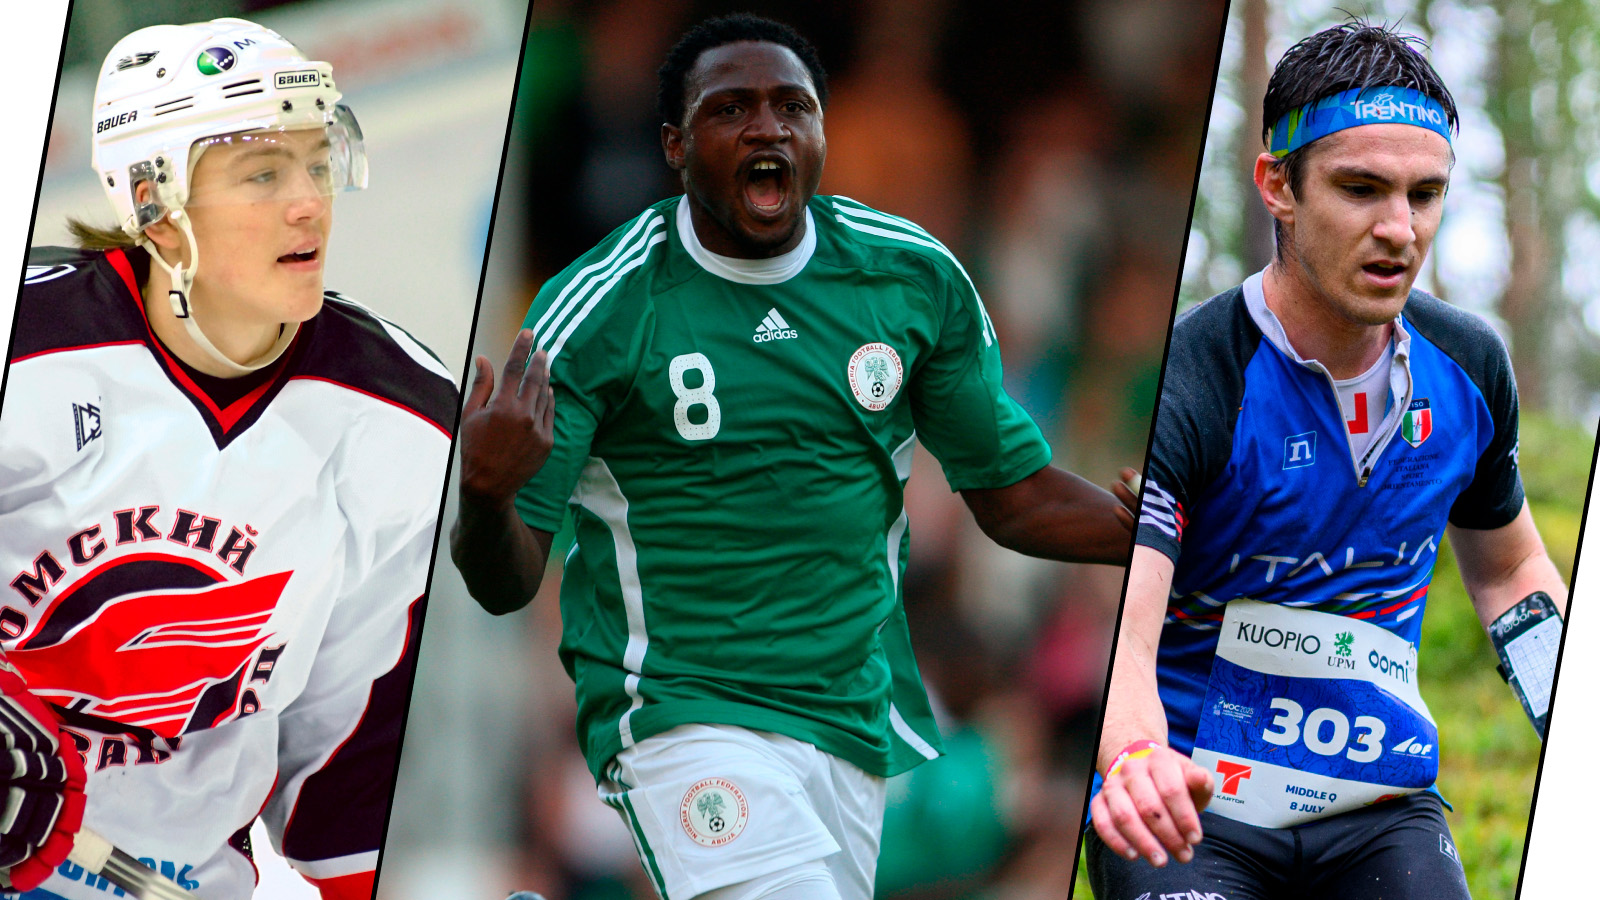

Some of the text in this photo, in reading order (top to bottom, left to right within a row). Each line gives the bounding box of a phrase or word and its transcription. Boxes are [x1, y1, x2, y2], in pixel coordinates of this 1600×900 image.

[1350, 100, 1442, 125] TRENTINO
[753, 327, 798, 343] adidas
[852, 345, 884, 364] FOOTBALL
[850, 365, 860, 396] NIGERIA
[669, 352, 721, 440] 8
[1229, 534, 1437, 583] ITALIA
[1237, 622, 1321, 654] KUOPIO
[1327, 656, 1356, 670] UPM
[1223, 701, 1240, 712] WOC
[1262, 697, 1387, 764] 303
[1285, 784, 1337, 803] MIDDLE Q
[682, 780, 747, 839] NIGERIA FOOTBALL FEDERATION
[1289, 801, 1325, 814] 8 JULY
[711, 832, 736, 845] ABUJA
